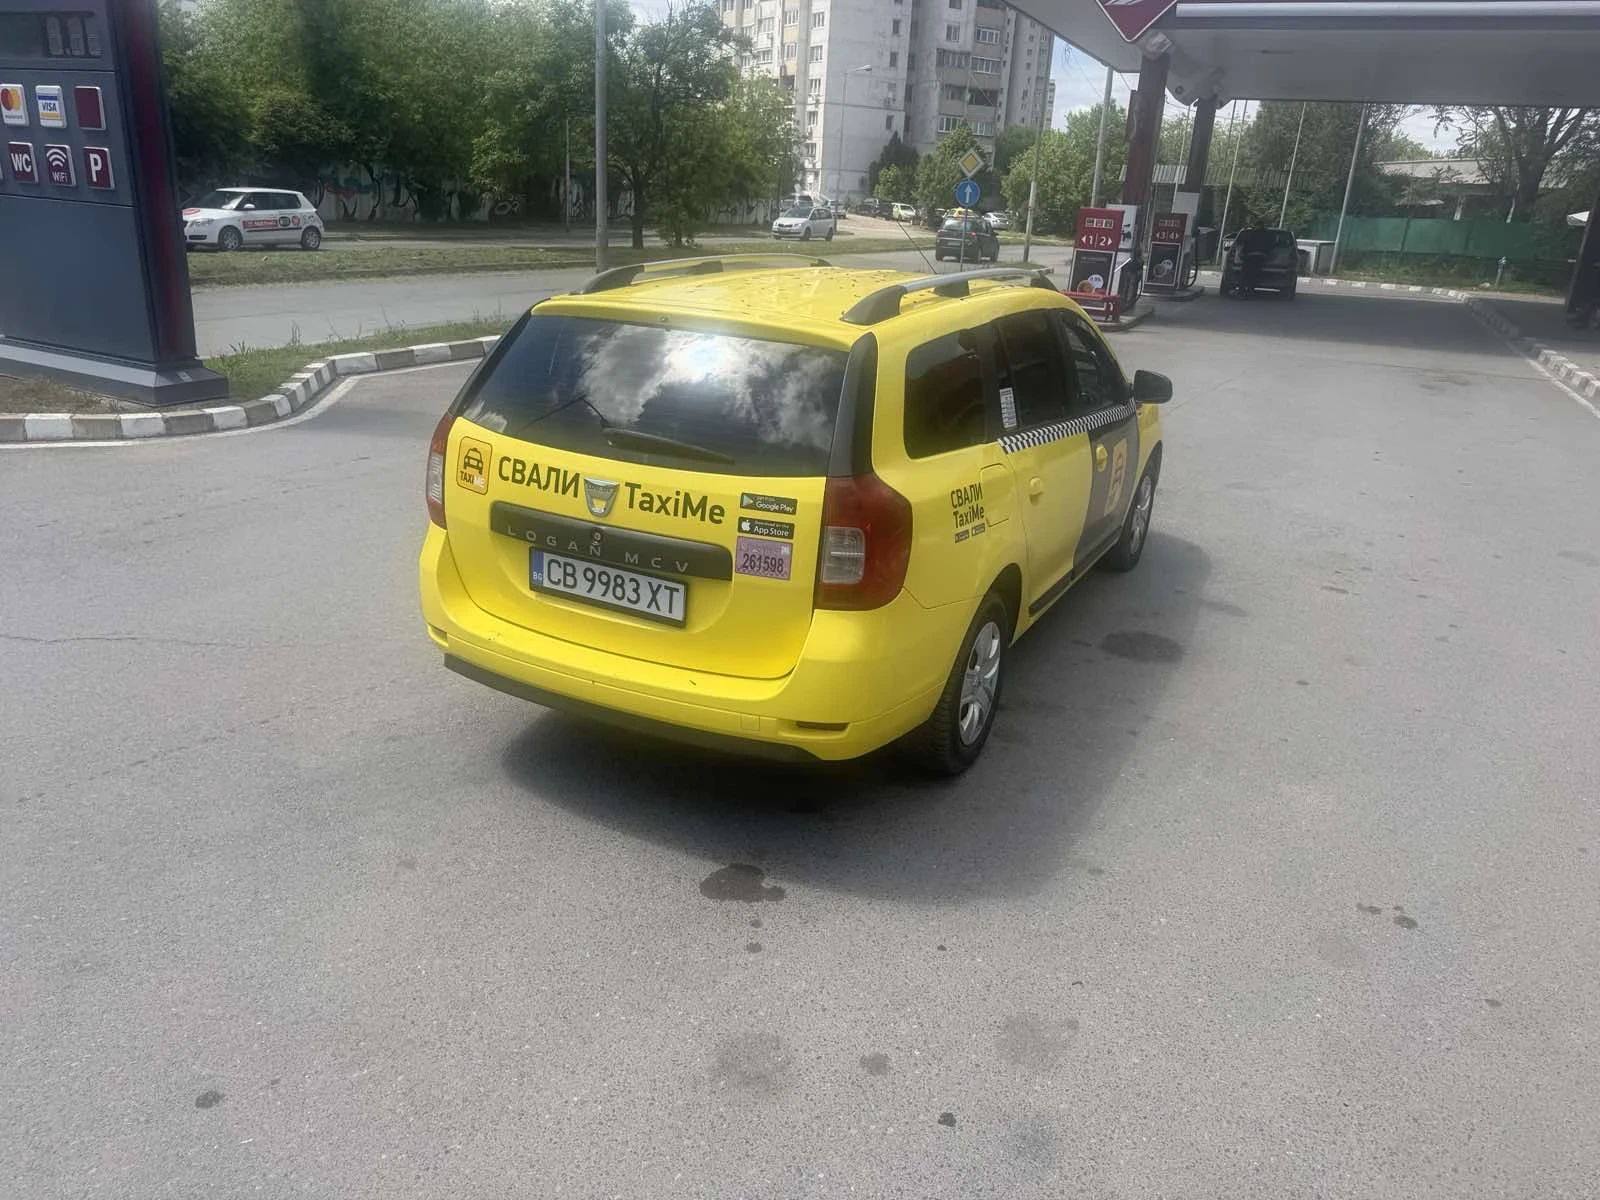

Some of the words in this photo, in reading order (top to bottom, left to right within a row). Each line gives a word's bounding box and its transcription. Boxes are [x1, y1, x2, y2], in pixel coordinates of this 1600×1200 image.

[41, 102, 58, 112] VISA
[10, 152, 32, 173] WC
[89, 153, 103, 182] P
[51, 171, 68, 182] WiFi
[1099, 236, 1106, 247] 2
[498, 456, 580, 498] СВАЛИ
[624, 482, 726, 525] TaxiMe
[755, 500, 779, 512] Google
[779, 503, 794, 513] Play
[950, 482, 983, 509] СВАЛИ
[952, 503, 985, 529] TaxiMe
[507, 525, 601, 556] LOGAN
[753, 525, 769, 535] App
[769, 527, 789, 537] Store
[742, 552, 784, 574] 261598
[582, 567, 641, 605] 9983
